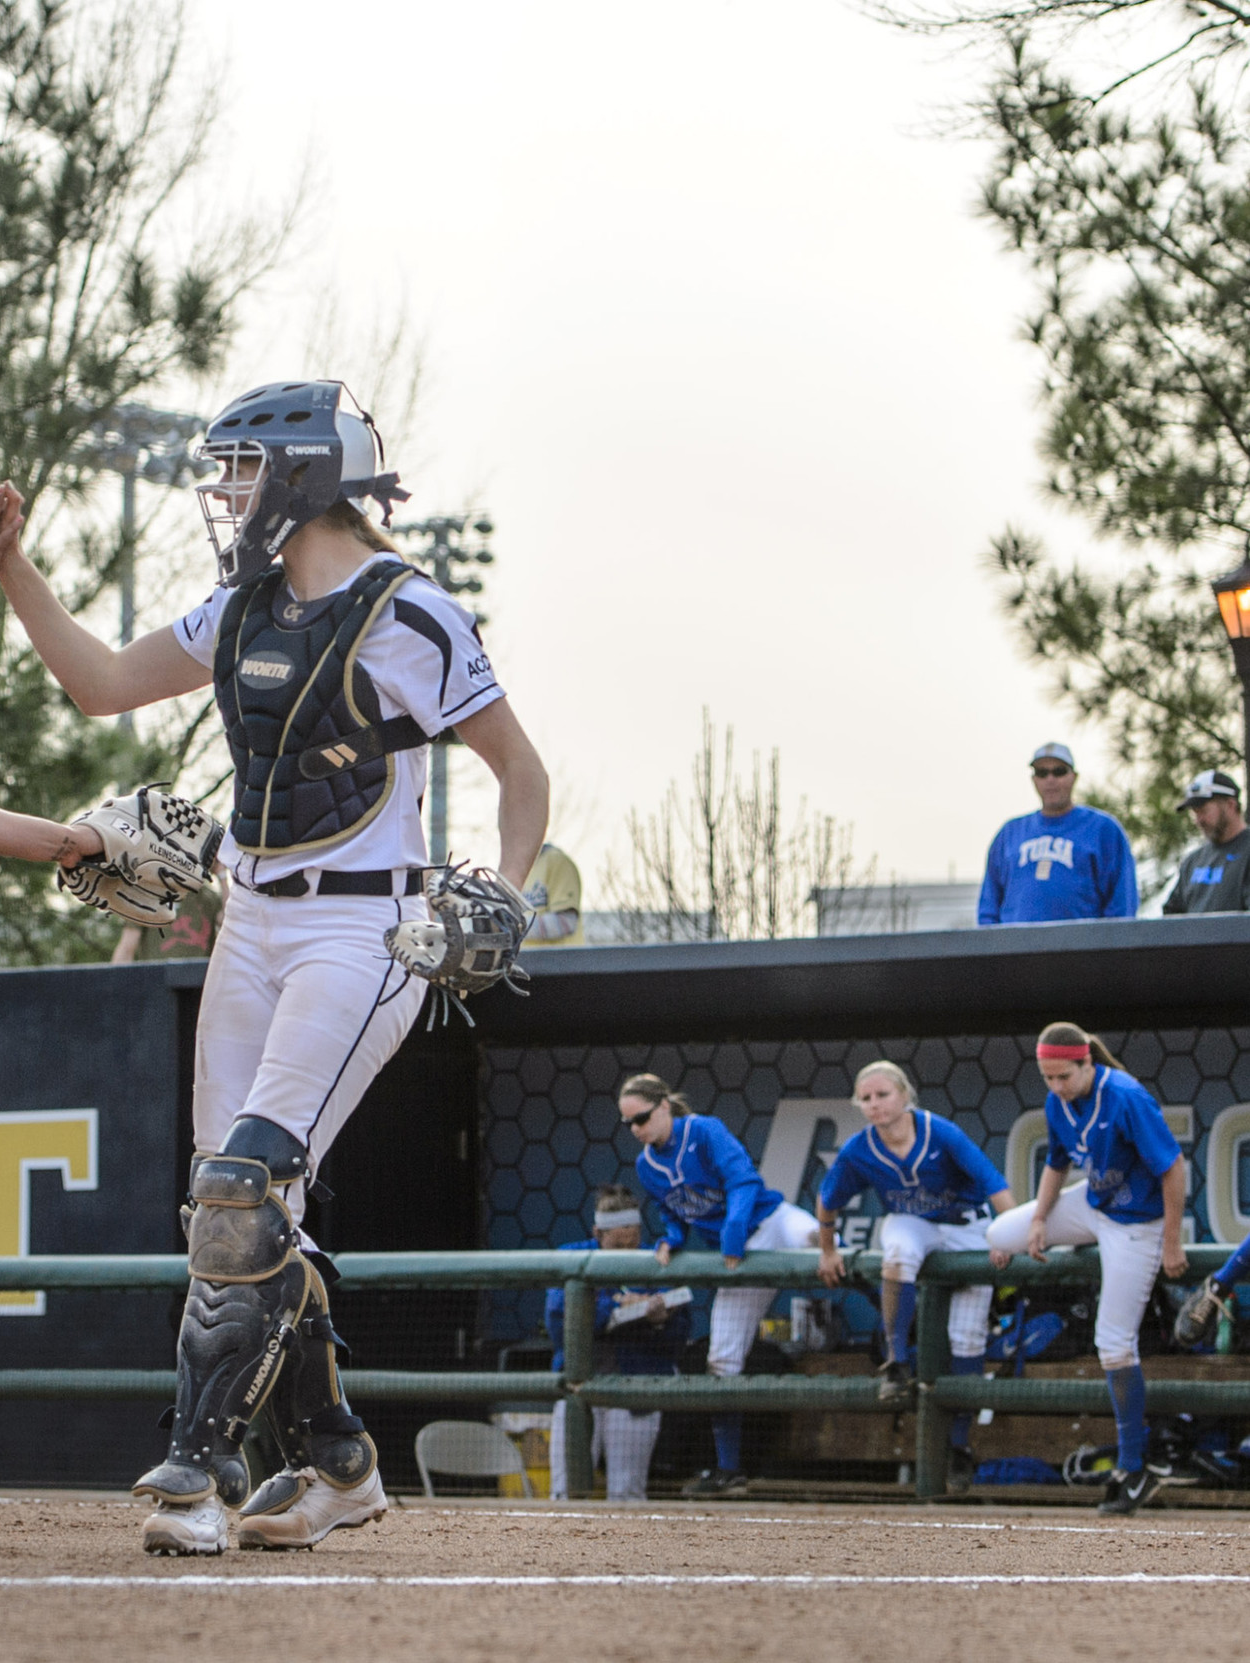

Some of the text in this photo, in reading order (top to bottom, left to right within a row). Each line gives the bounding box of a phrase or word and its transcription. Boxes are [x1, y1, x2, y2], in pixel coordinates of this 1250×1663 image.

[294, 445, 331, 456] WORTH
[271, 517, 297, 547] WORTH
[283, 603, 304, 622] GT
[241, 659, 291, 679] WORTH
[120, 823, 137, 838] 21
[149, 842, 197, 873] KLEINSCHMIDT
[1018, 835, 1074, 868] TULSA
[244, 1352, 275, 1405] WORTH
